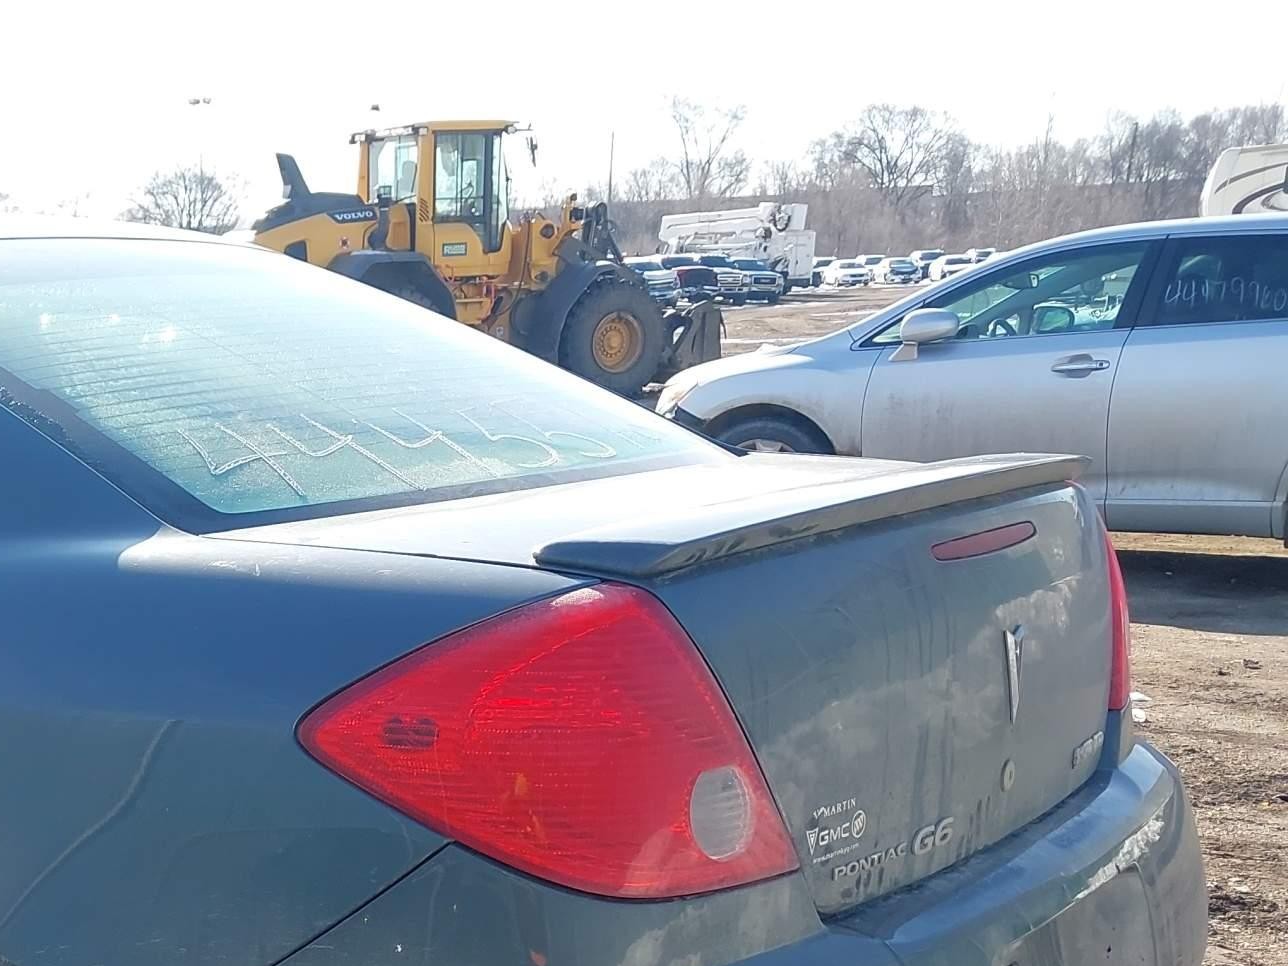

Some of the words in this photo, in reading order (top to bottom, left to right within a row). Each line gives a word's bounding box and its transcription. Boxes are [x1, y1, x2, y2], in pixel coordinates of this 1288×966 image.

[334, 210, 373, 220] VOLVO
[821, 797, 856, 818] MARTIN
[818, 822, 850, 846] GMC
[833, 842, 908, 881] PONTIAC
[914, 816, 954, 856] G6
